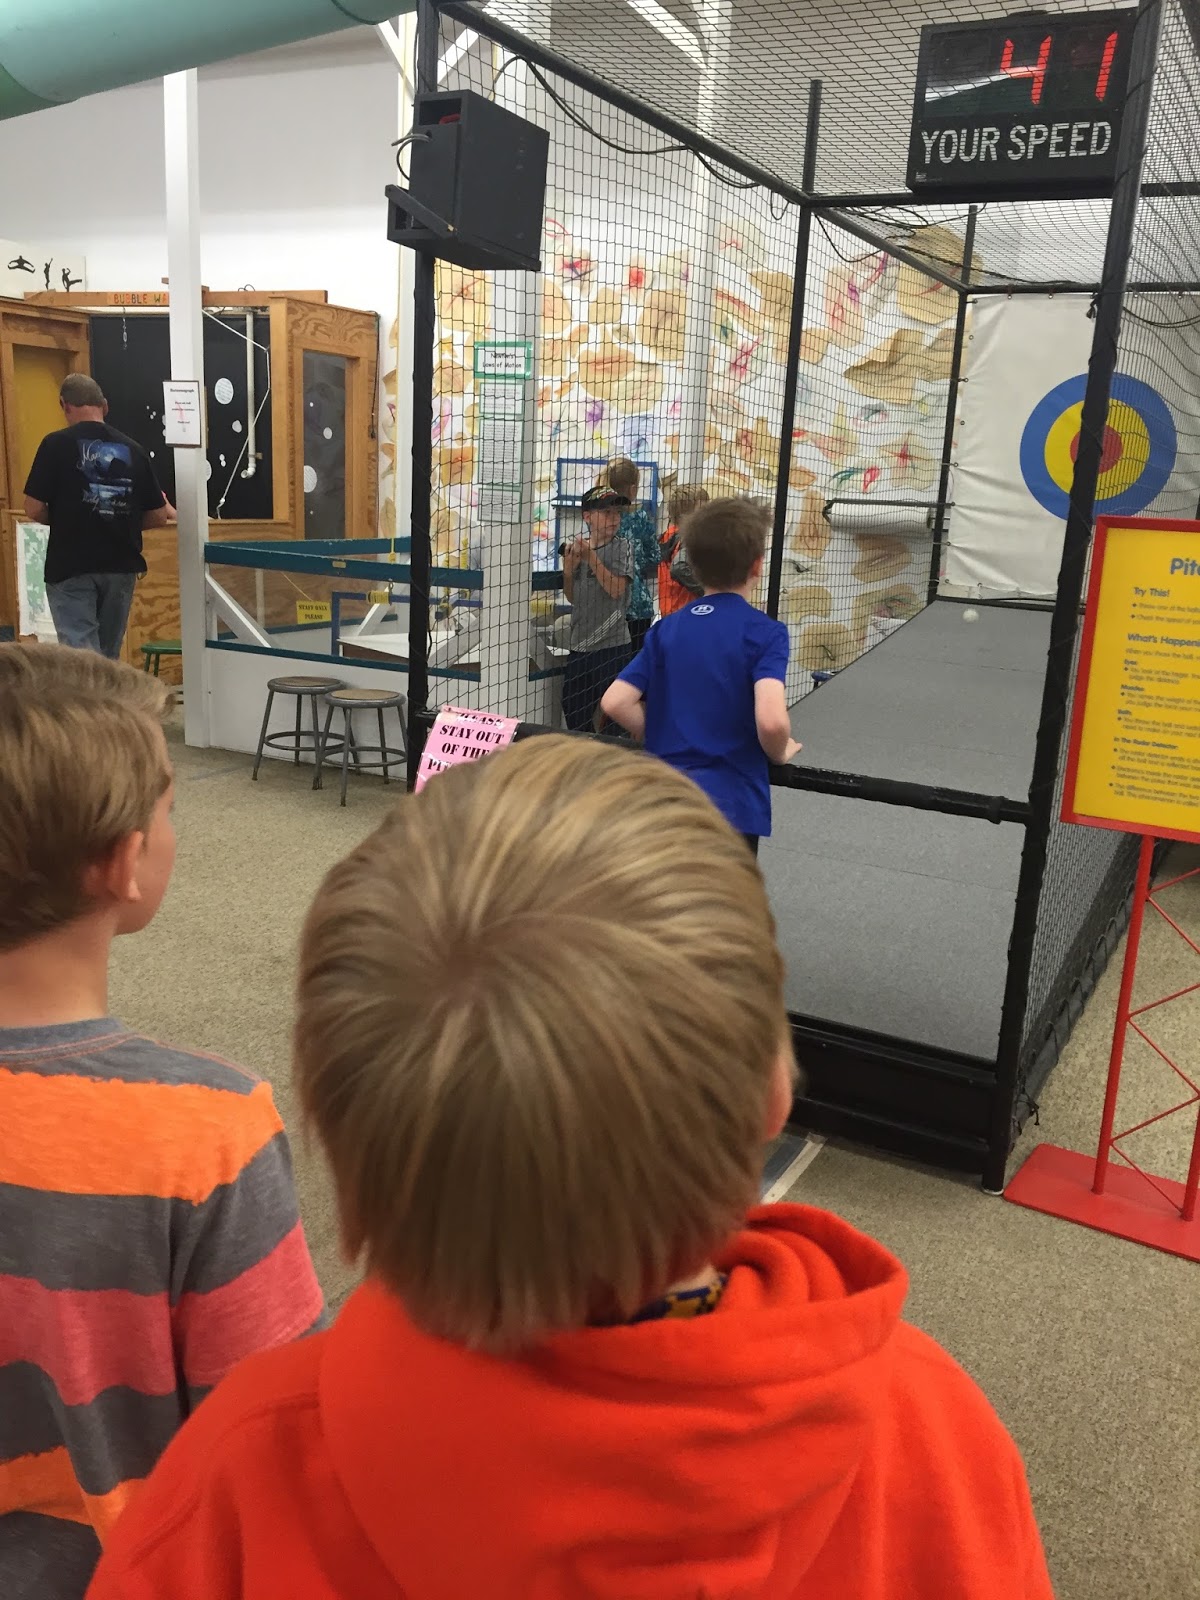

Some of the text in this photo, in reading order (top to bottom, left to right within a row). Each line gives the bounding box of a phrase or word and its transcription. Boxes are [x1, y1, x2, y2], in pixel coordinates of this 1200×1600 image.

[1000, 31, 1118, 105] 41
[921, 121, 1112, 164] YOUR SPEED
[113, 293, 148, 304] BUBBLE
[1134, 587, 1170, 597] Try This!
[1127, 632, 1157, 643] What's
[440, 724, 505, 744] STAY OUT
[442, 742, 460, 755] OF
